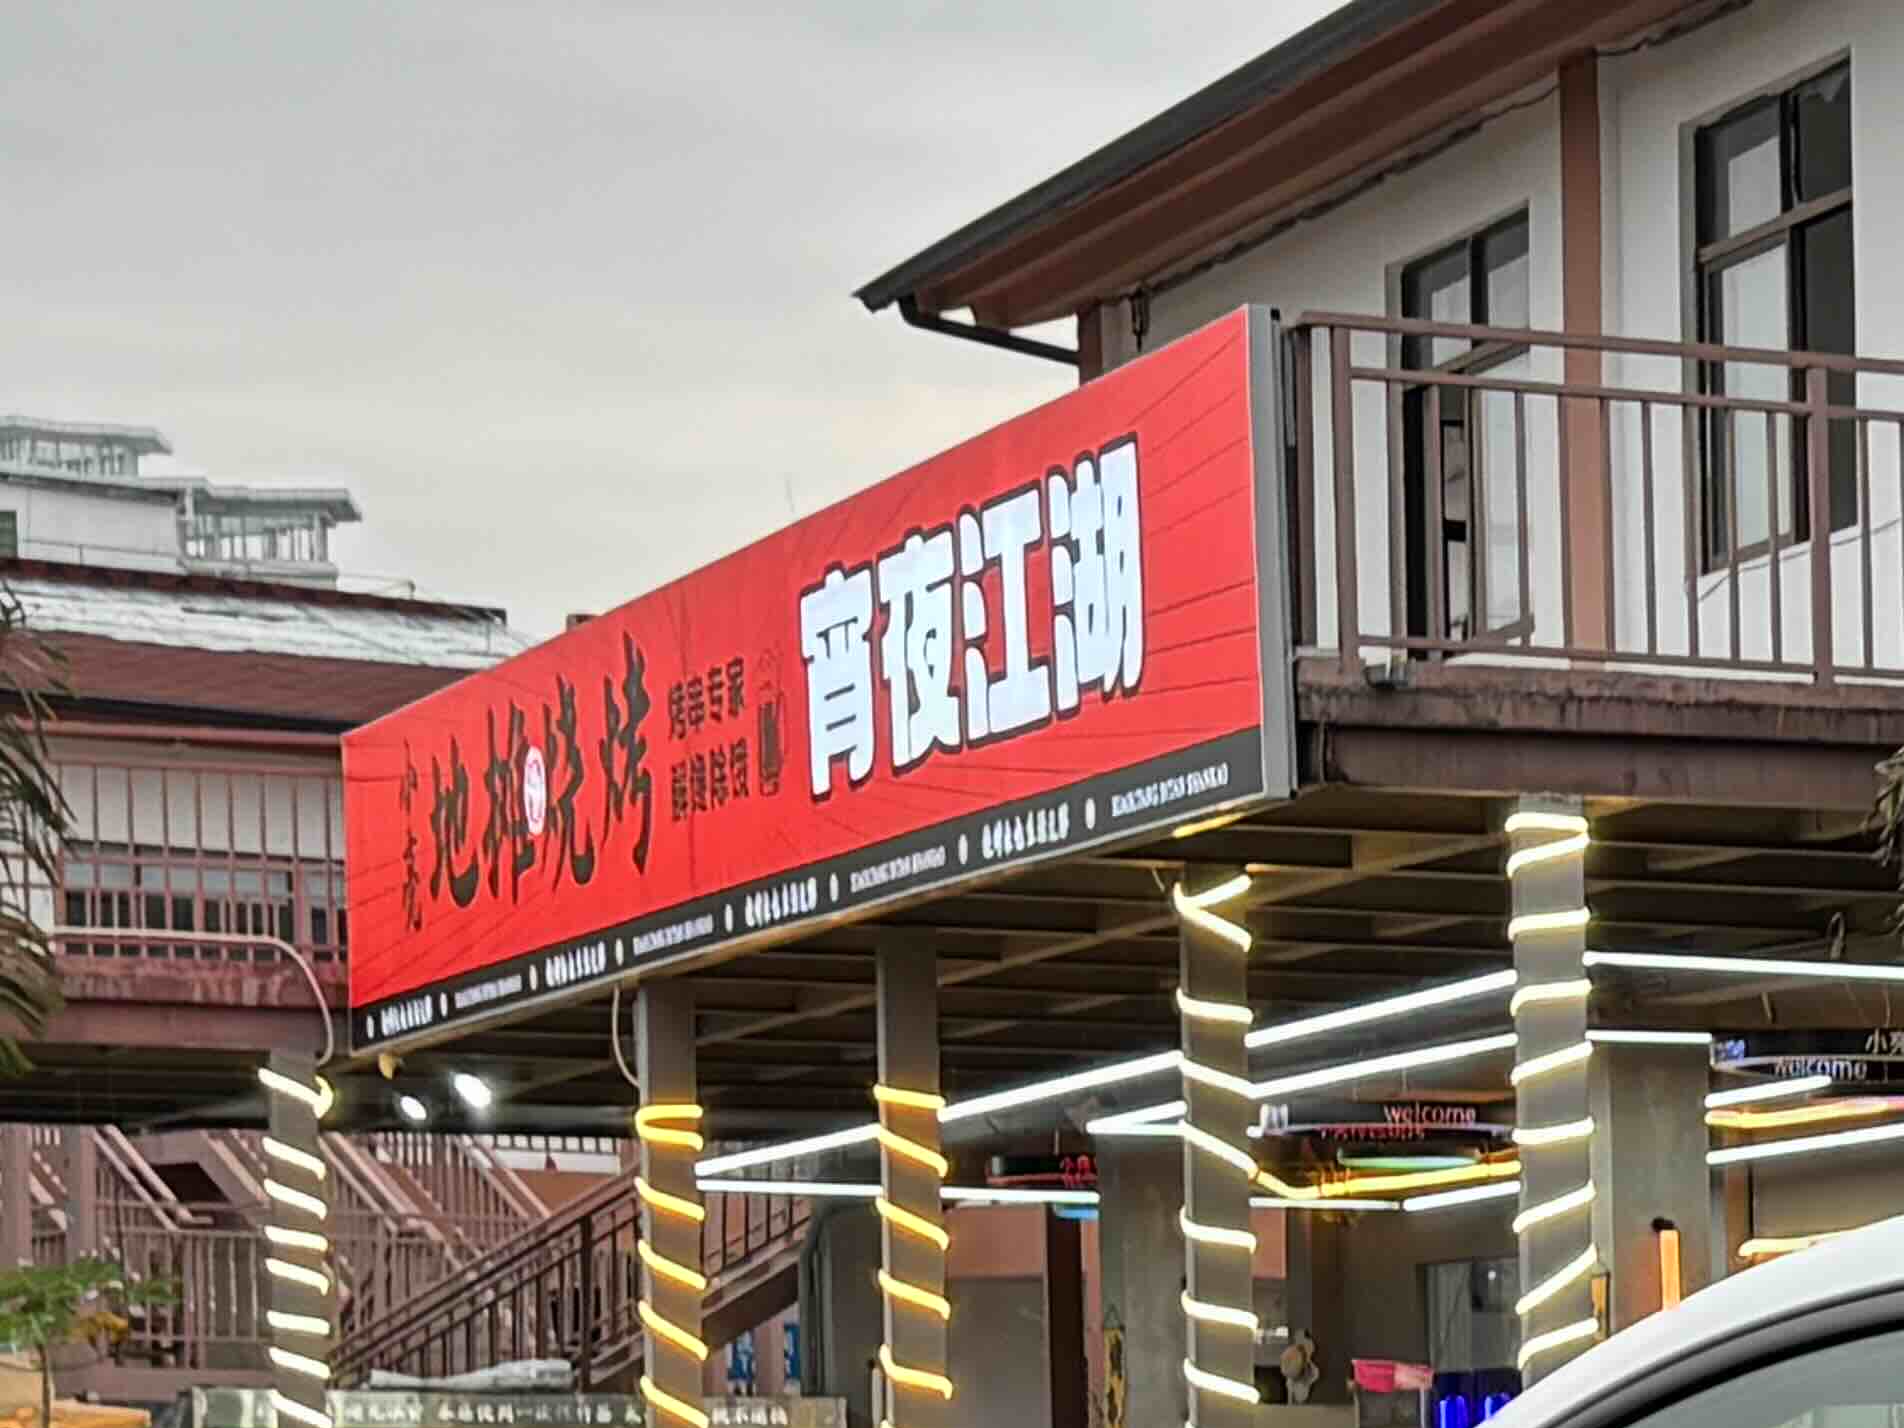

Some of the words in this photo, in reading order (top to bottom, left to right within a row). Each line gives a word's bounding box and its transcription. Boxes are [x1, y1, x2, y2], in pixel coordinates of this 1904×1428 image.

[800, 431, 1145, 802] 宵夜江湖
[1383, 1102, 1477, 1124] welcome
